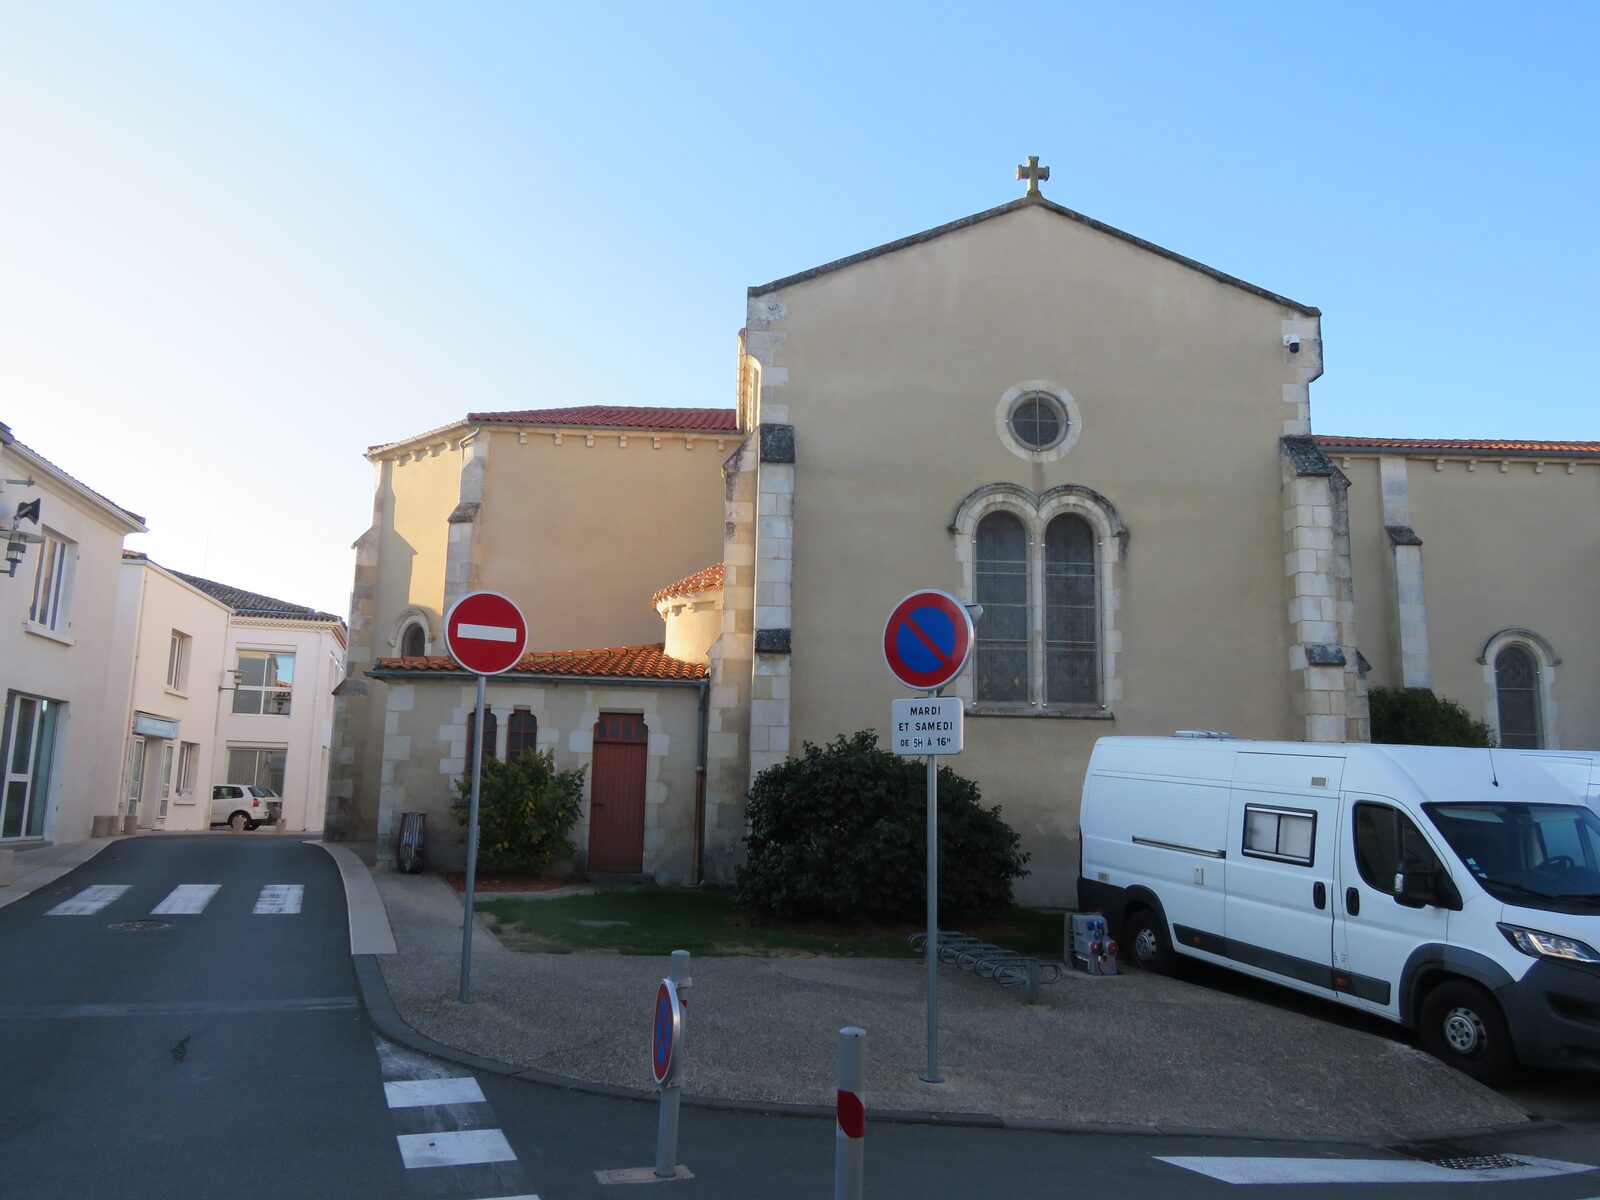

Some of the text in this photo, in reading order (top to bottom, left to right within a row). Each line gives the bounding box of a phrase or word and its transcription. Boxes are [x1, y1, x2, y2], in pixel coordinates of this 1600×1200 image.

[910, 706, 941, 716] MARDI
[898, 721, 953, 732] ET SAMEDI
[900, 739, 909, 747] DE
